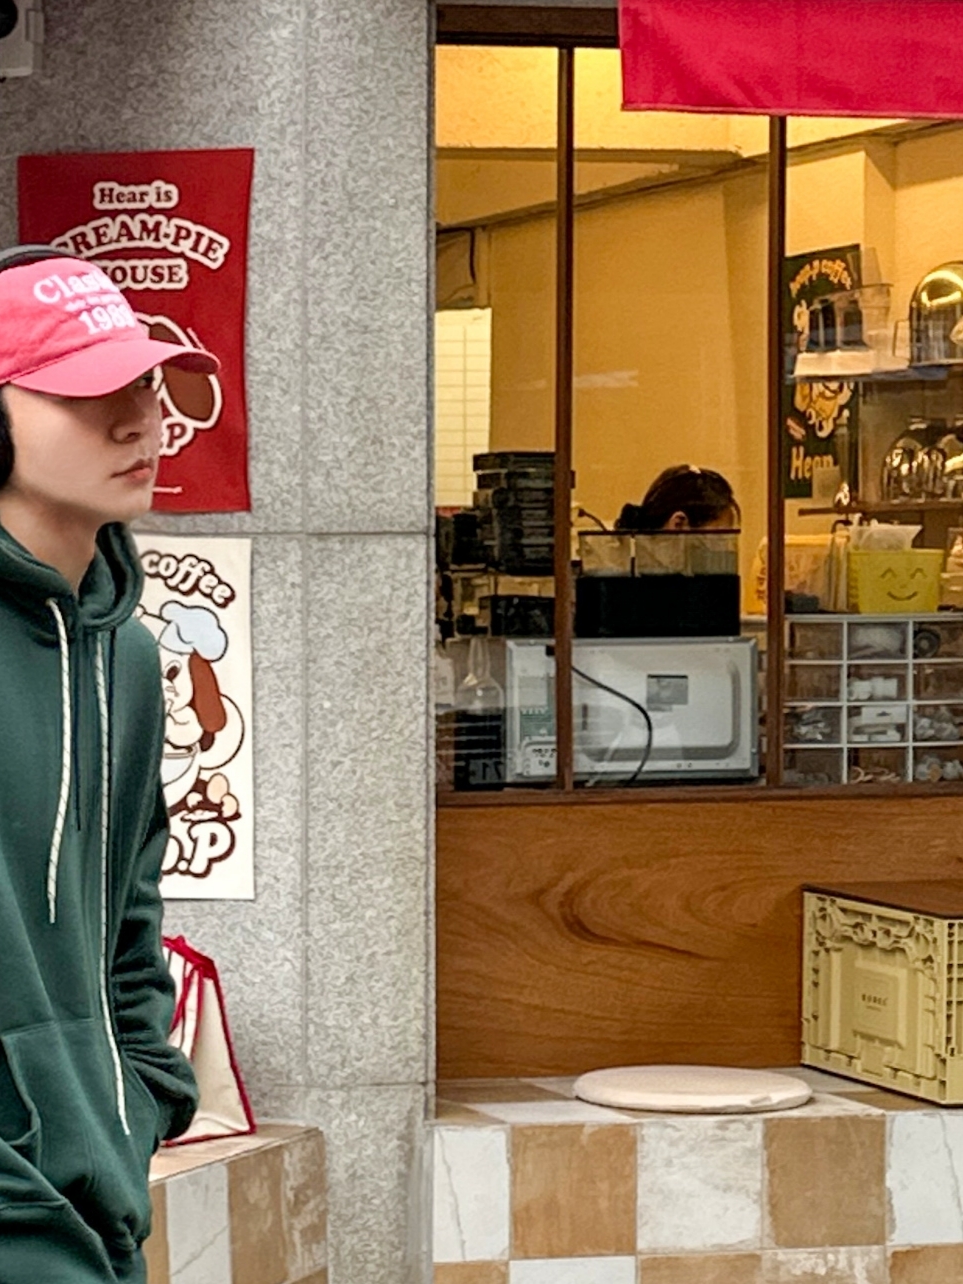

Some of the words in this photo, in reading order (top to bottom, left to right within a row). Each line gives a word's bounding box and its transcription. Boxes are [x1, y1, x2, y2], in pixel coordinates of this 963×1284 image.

[98, 186, 149, 204] Hear
[154, 185, 173, 203] is
[55, 219, 225, 263] REAM-PIE
[104, 264, 184, 285] OUSE
[140, 550, 235, 608] coffee
